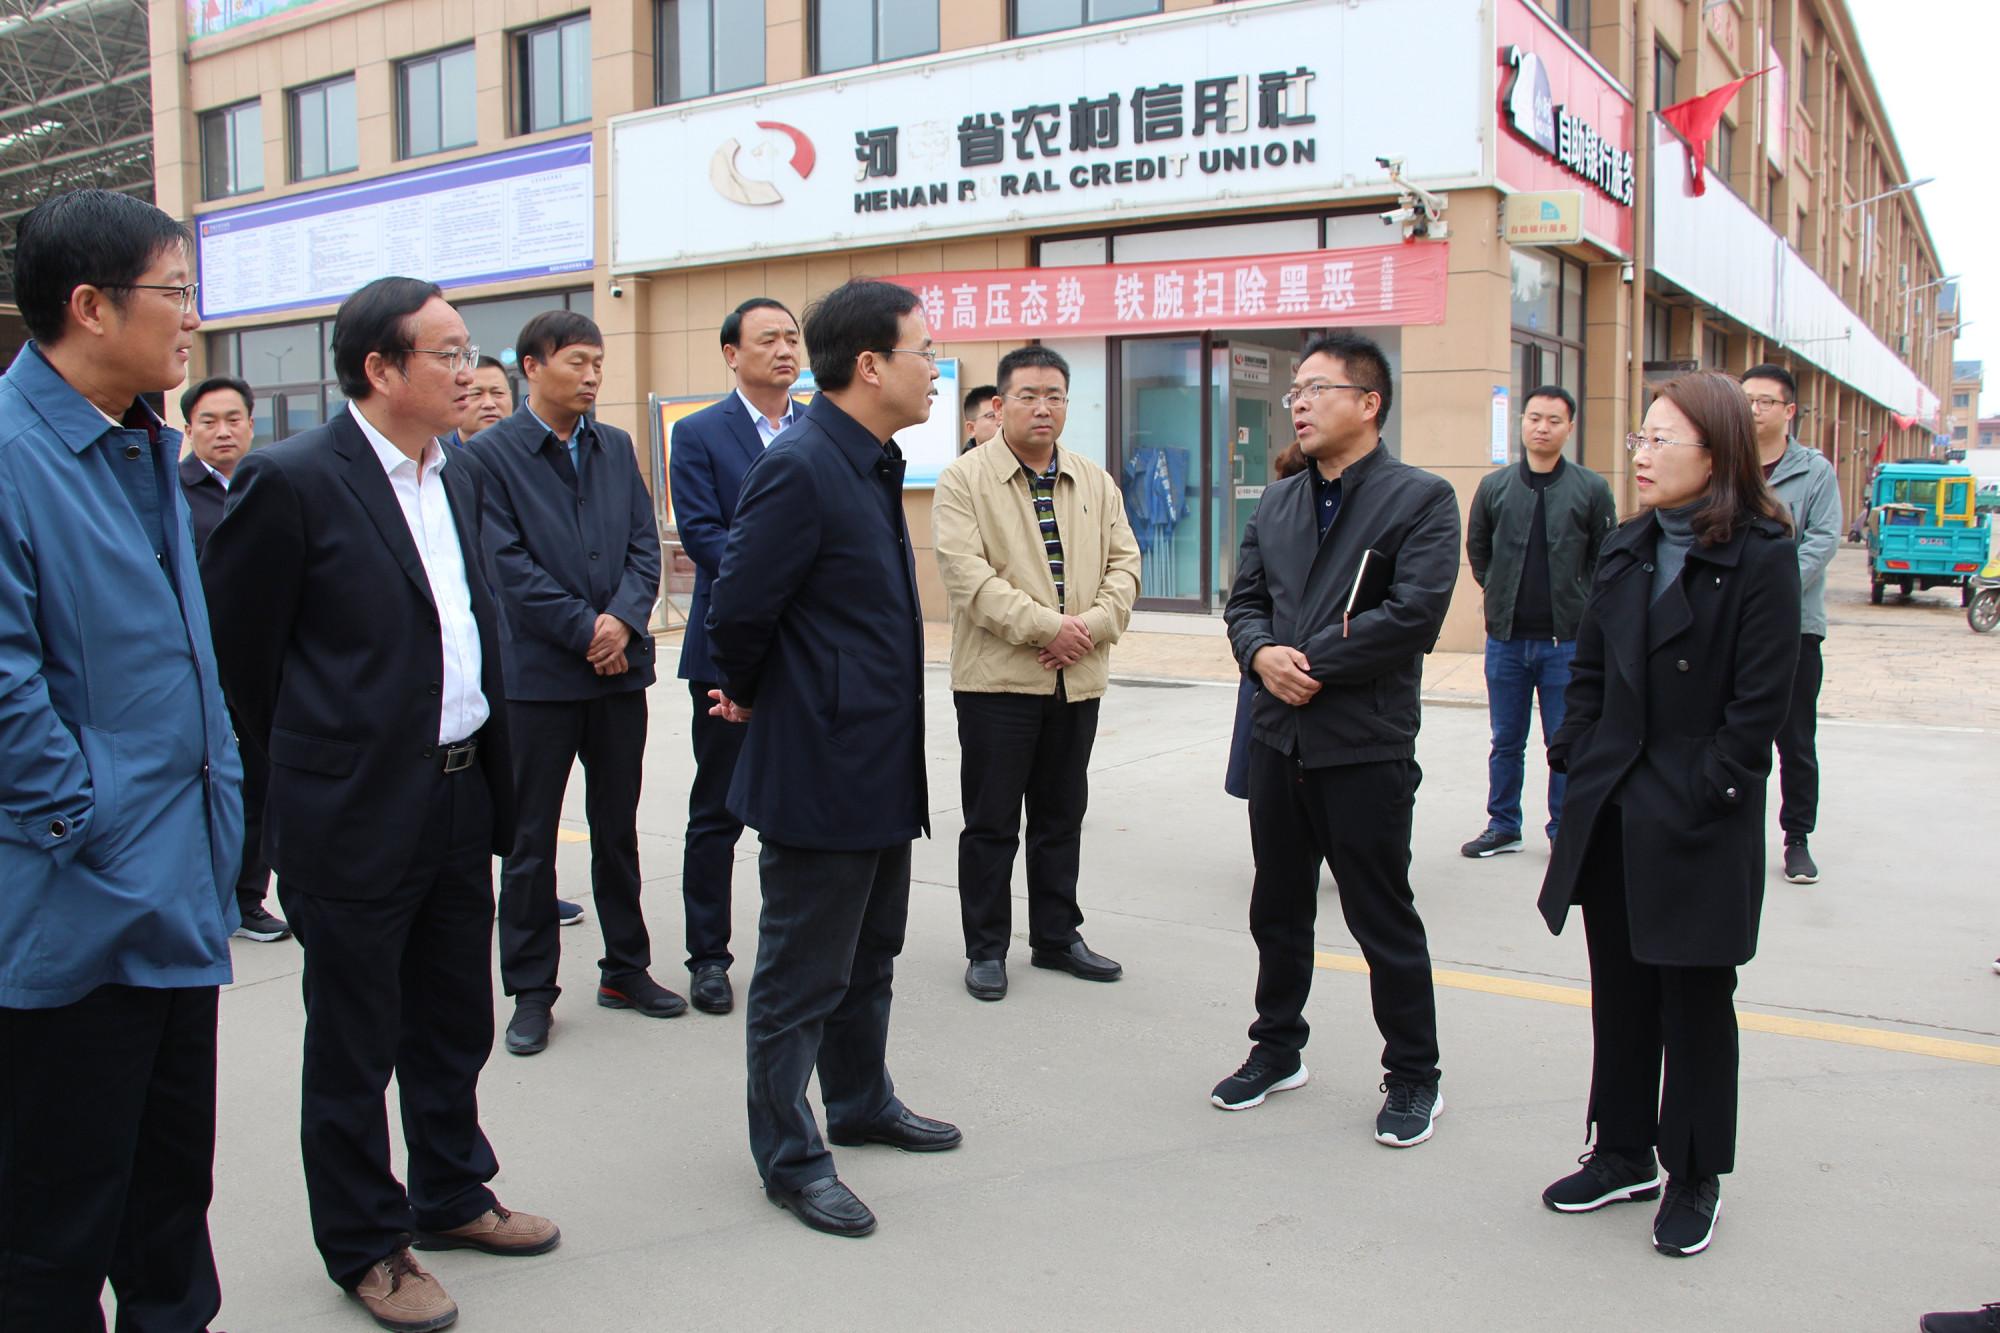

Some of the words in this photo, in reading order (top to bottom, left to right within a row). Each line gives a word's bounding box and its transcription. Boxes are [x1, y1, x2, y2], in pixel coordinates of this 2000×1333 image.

[854, 66, 1317, 182] 河省农村信用社
[1558, 104, 1634, 207] 自助银行服务
[853, 182, 948, 213] HENAN
[1069, 152, 1189, 188] CREDIT
[1199, 138, 1316, 174] UNION
[918, 276, 1086, 331] 持高压态势
[1114, 259, 1357, 321] 铁腕扫除黑恶
